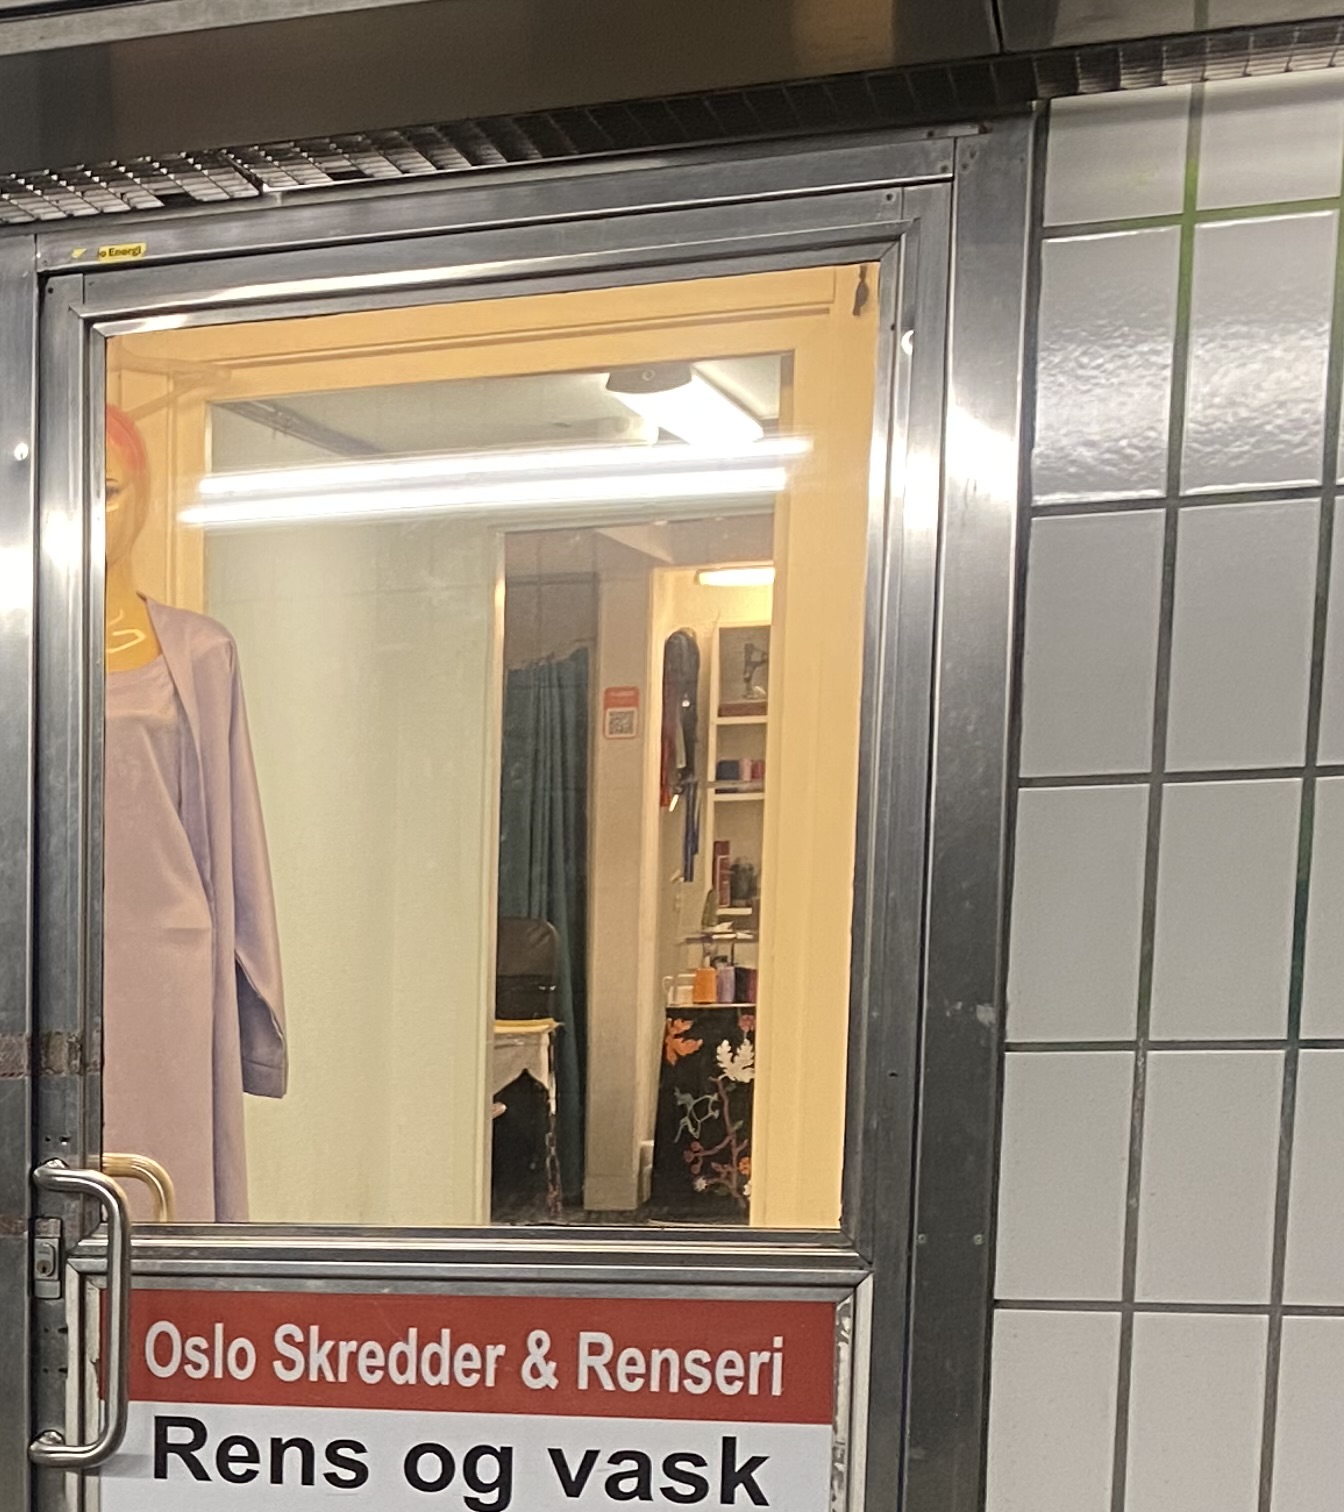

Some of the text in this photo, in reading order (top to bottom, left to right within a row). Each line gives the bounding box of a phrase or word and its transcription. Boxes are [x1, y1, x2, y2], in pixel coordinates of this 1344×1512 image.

[145, 1320, 784, 1397] Oslo Skredder & Renseri
[153, 1415, 771, 1512] Rens og vask
